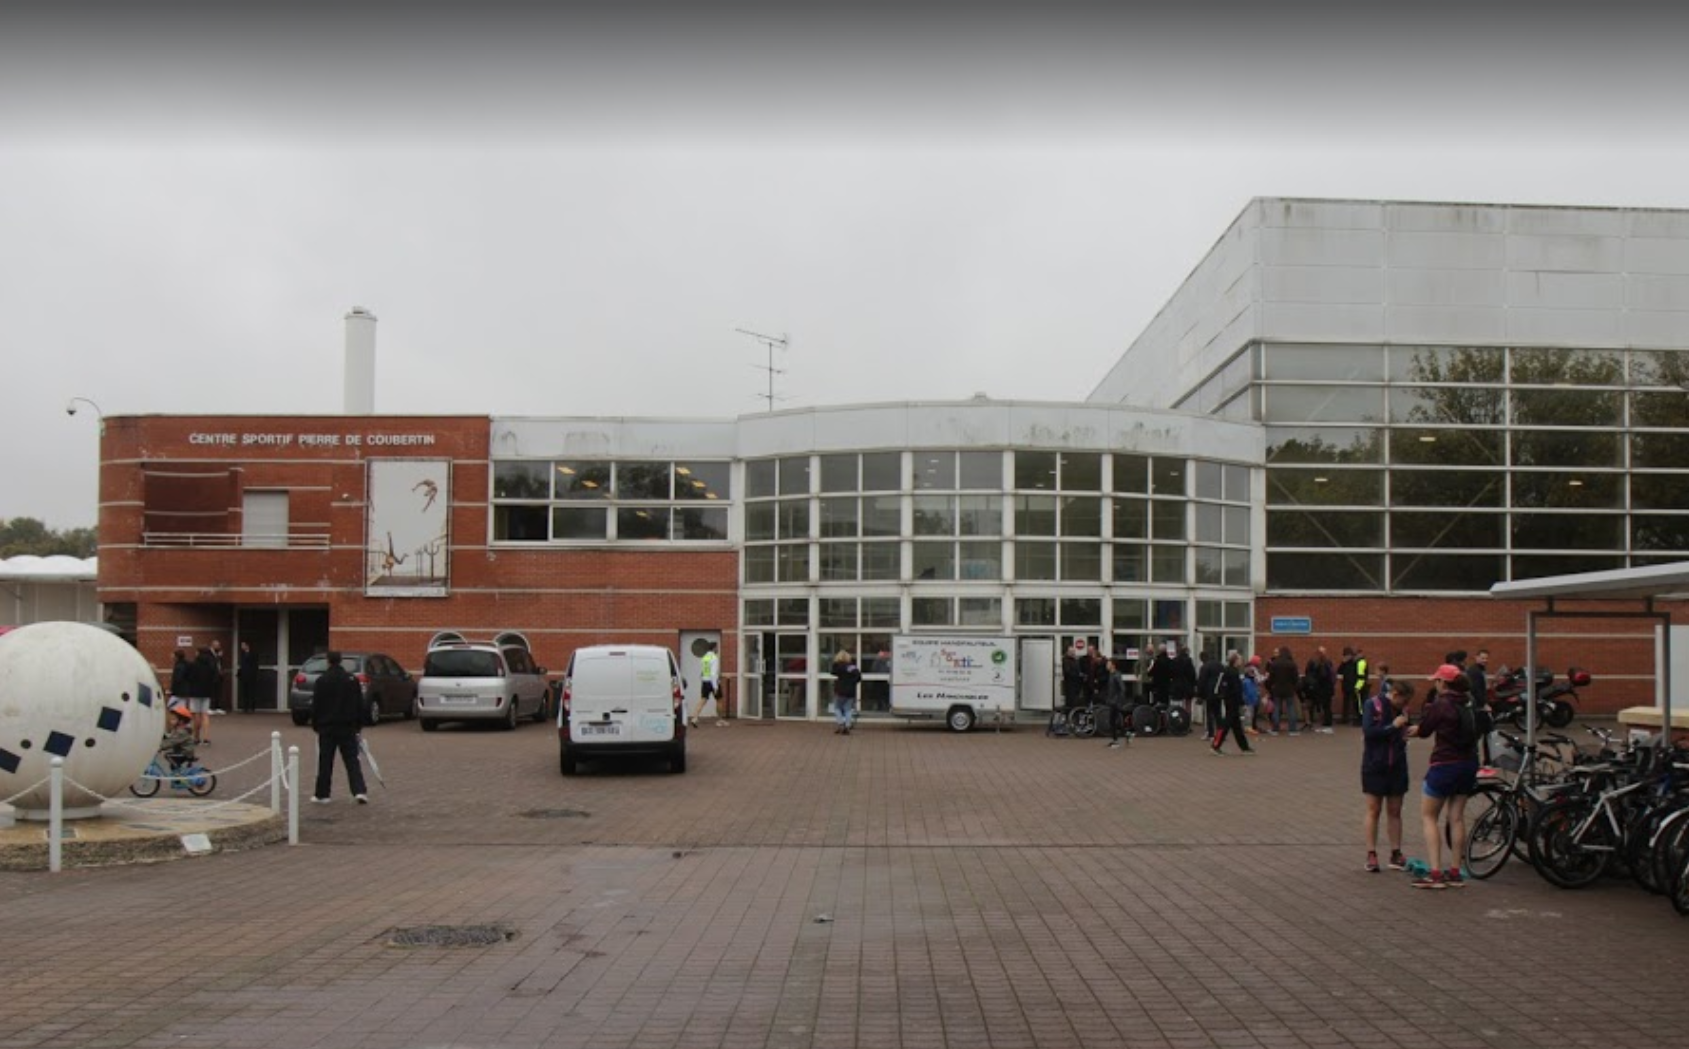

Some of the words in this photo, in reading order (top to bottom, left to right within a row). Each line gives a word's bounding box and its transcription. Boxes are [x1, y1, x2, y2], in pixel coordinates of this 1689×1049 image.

[189, 433, 237, 444] CENTRE
[242, 433, 293, 445] SPORTIF
[298, 434, 340, 445] PIERRE
[345, 434, 362, 445] DE
[366, 434, 435, 446] COUBERTIN
